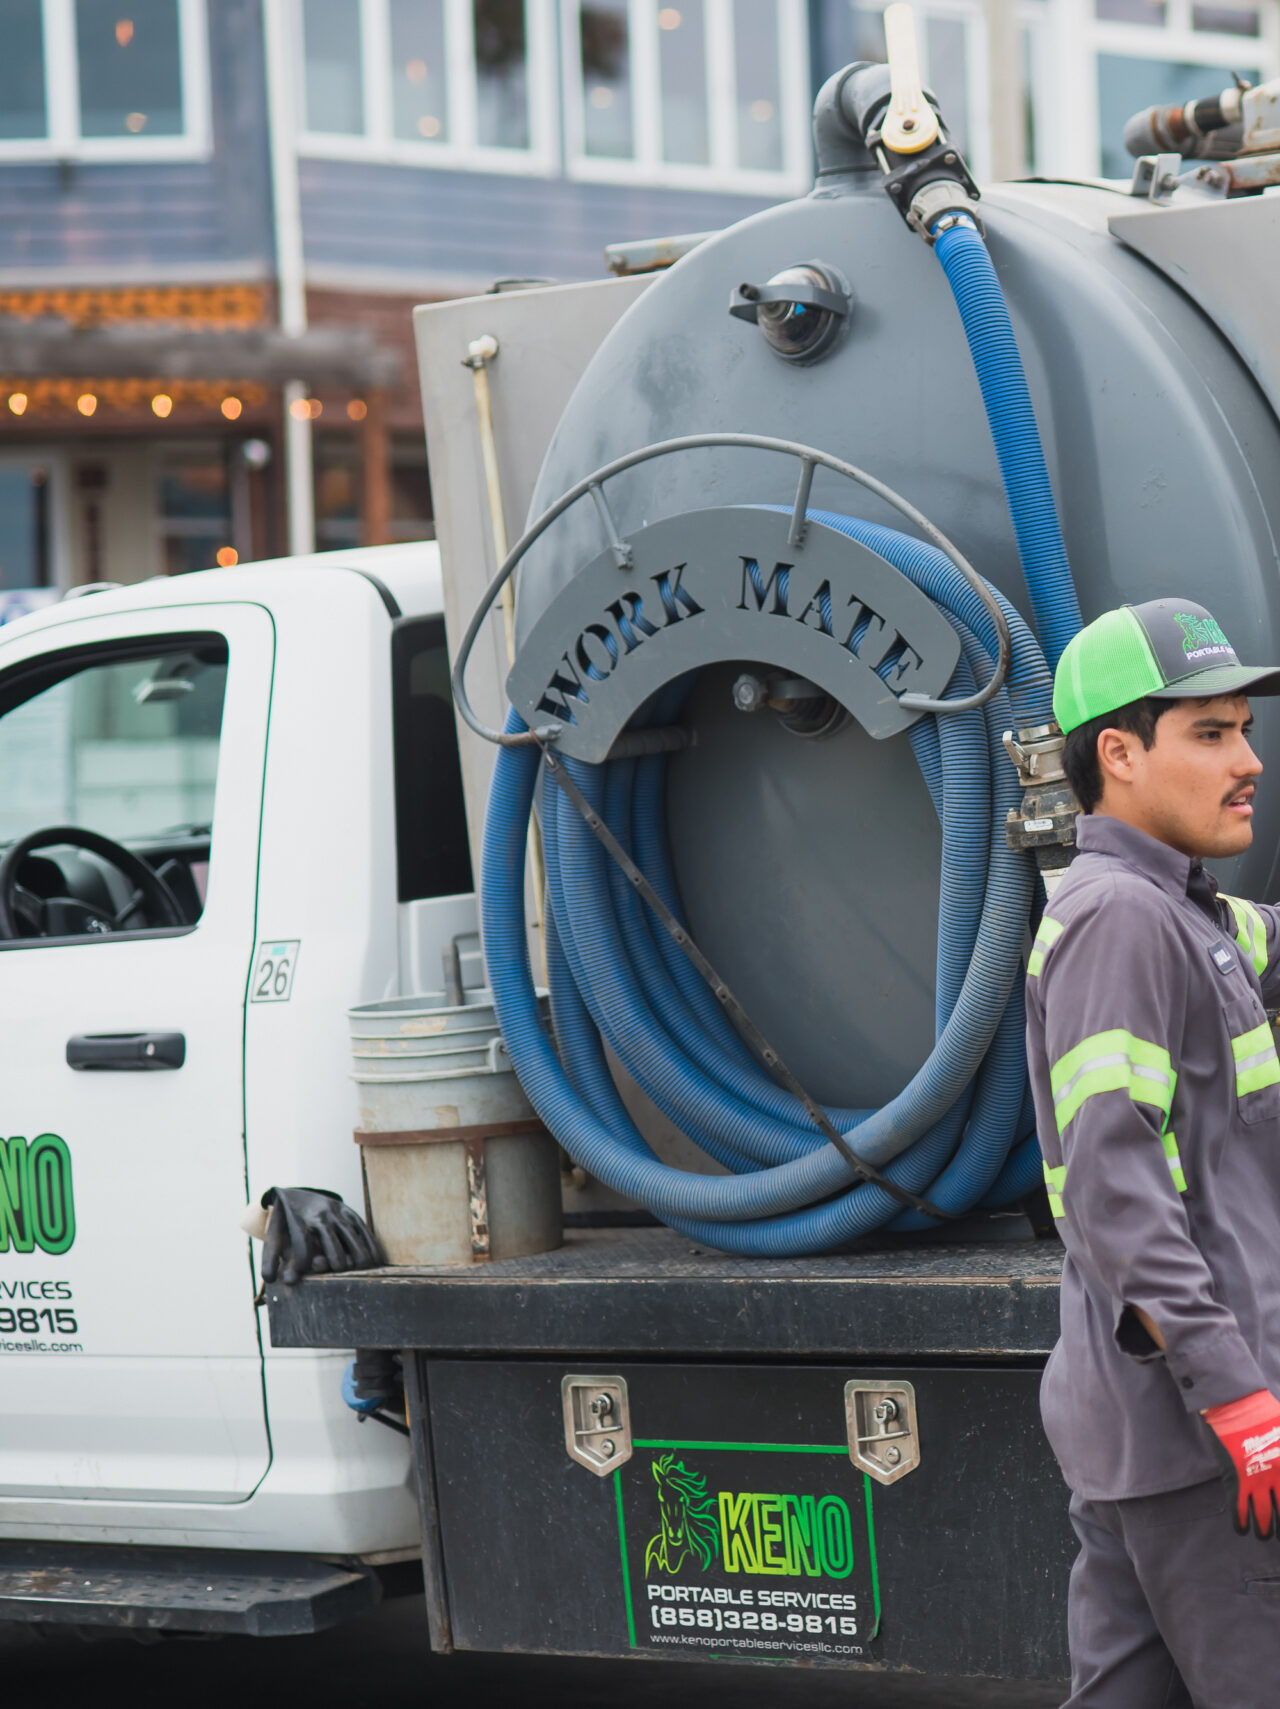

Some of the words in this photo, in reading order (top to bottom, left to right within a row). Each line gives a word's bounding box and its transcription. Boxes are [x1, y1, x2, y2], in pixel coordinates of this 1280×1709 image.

[534, 562, 705, 726] WORK
[735, 555, 924, 699] MATE
[256, 959, 290, 997] 26
[0, 1280, 73, 1300] VICES
[717, 1491, 855, 1580] KENO
[647, 1584, 754, 1605] PORTABLE
[757, 1590, 857, 1611] SERVICES
[651, 1604, 858, 1636] (858)328-9815
[650, 1633, 863, 1655] www.kenoportableservicesllc.com
